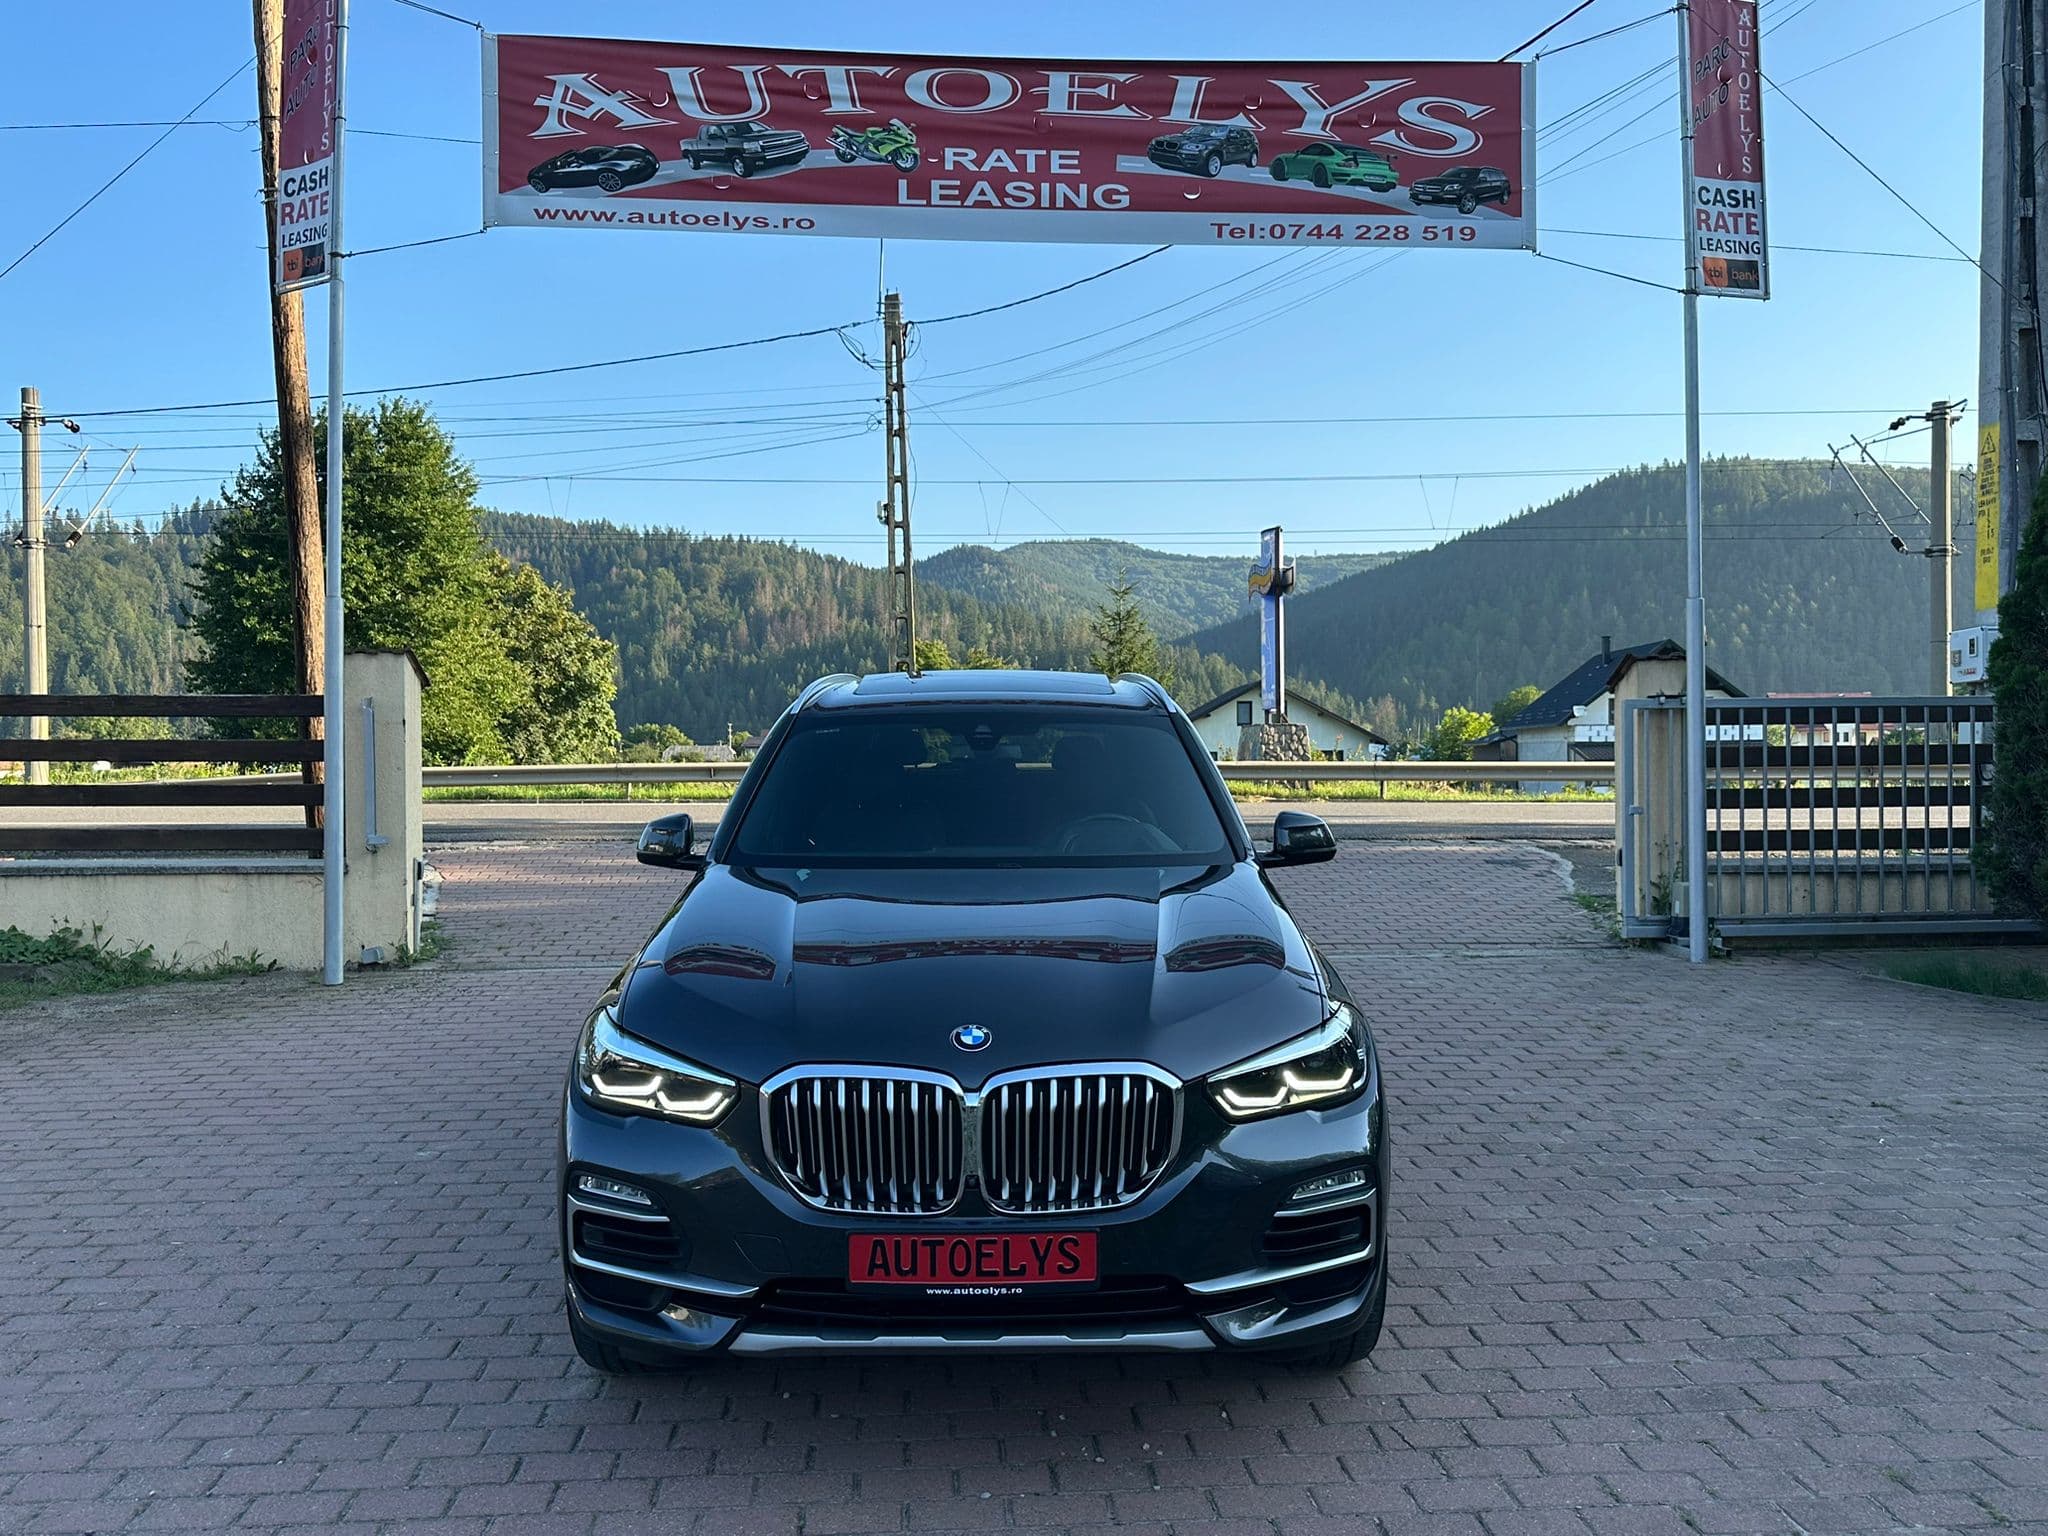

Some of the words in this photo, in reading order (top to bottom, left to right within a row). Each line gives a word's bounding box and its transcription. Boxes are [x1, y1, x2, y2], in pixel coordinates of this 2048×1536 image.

[1695, 36, 1730, 85] PARC
[1693, 81, 1729, 129] AUTO
[1738, 8, 1754, 174] AUTOELYS
[528, 63, 1496, 159] AUTOELYS
[943, 147, 1082, 175] RATE
[284, 166, 328, 197] CASH
[897, 179, 1131, 210] LEASING
[281, 191, 329, 225] RATE
[1697, 185, 1756, 209] CASH
[533, 206, 816, 231] www.autoelys.ro
[1210, 222, 1344, 241] Tel:0744
[1354, 224, 1412, 241] 228
[1421, 224, 1477, 242] 519
[1696, 208, 1760, 235] RATE
[282, 223, 328, 248] LEASING
[1699, 236, 1761, 255] LEASING
[1731, 268, 1759, 281] bank
[867, 1235, 1081, 1277] AUTOELYS
[926, 1285, 1023, 1296] www.autoelys.ro
